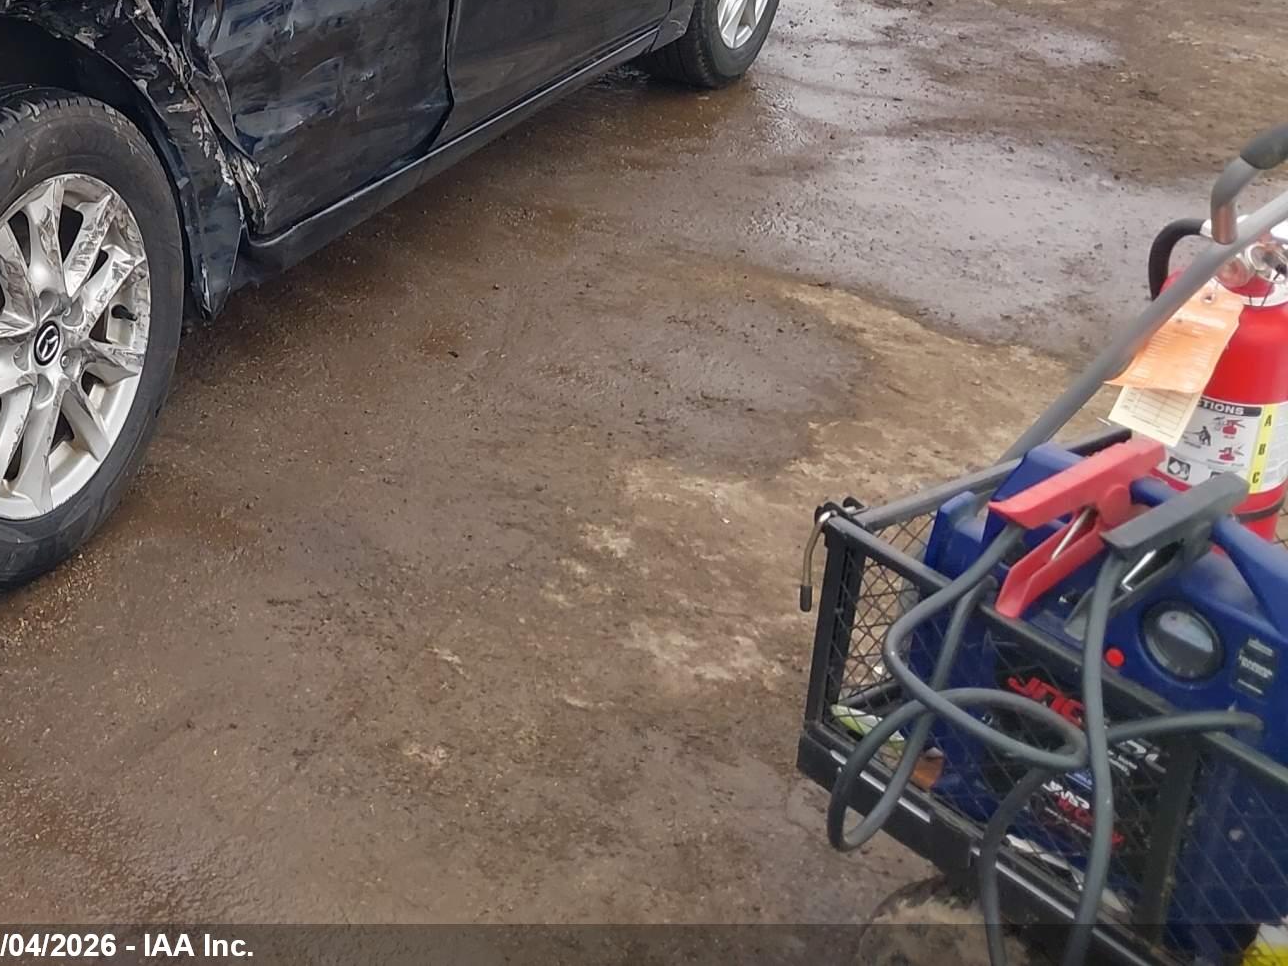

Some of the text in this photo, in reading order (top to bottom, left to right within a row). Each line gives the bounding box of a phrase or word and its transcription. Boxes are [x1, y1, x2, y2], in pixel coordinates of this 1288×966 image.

[1263, 414, 1273, 427] A
[1257, 443, 1267, 455] B
[1251, 471, 1261, 484] C
